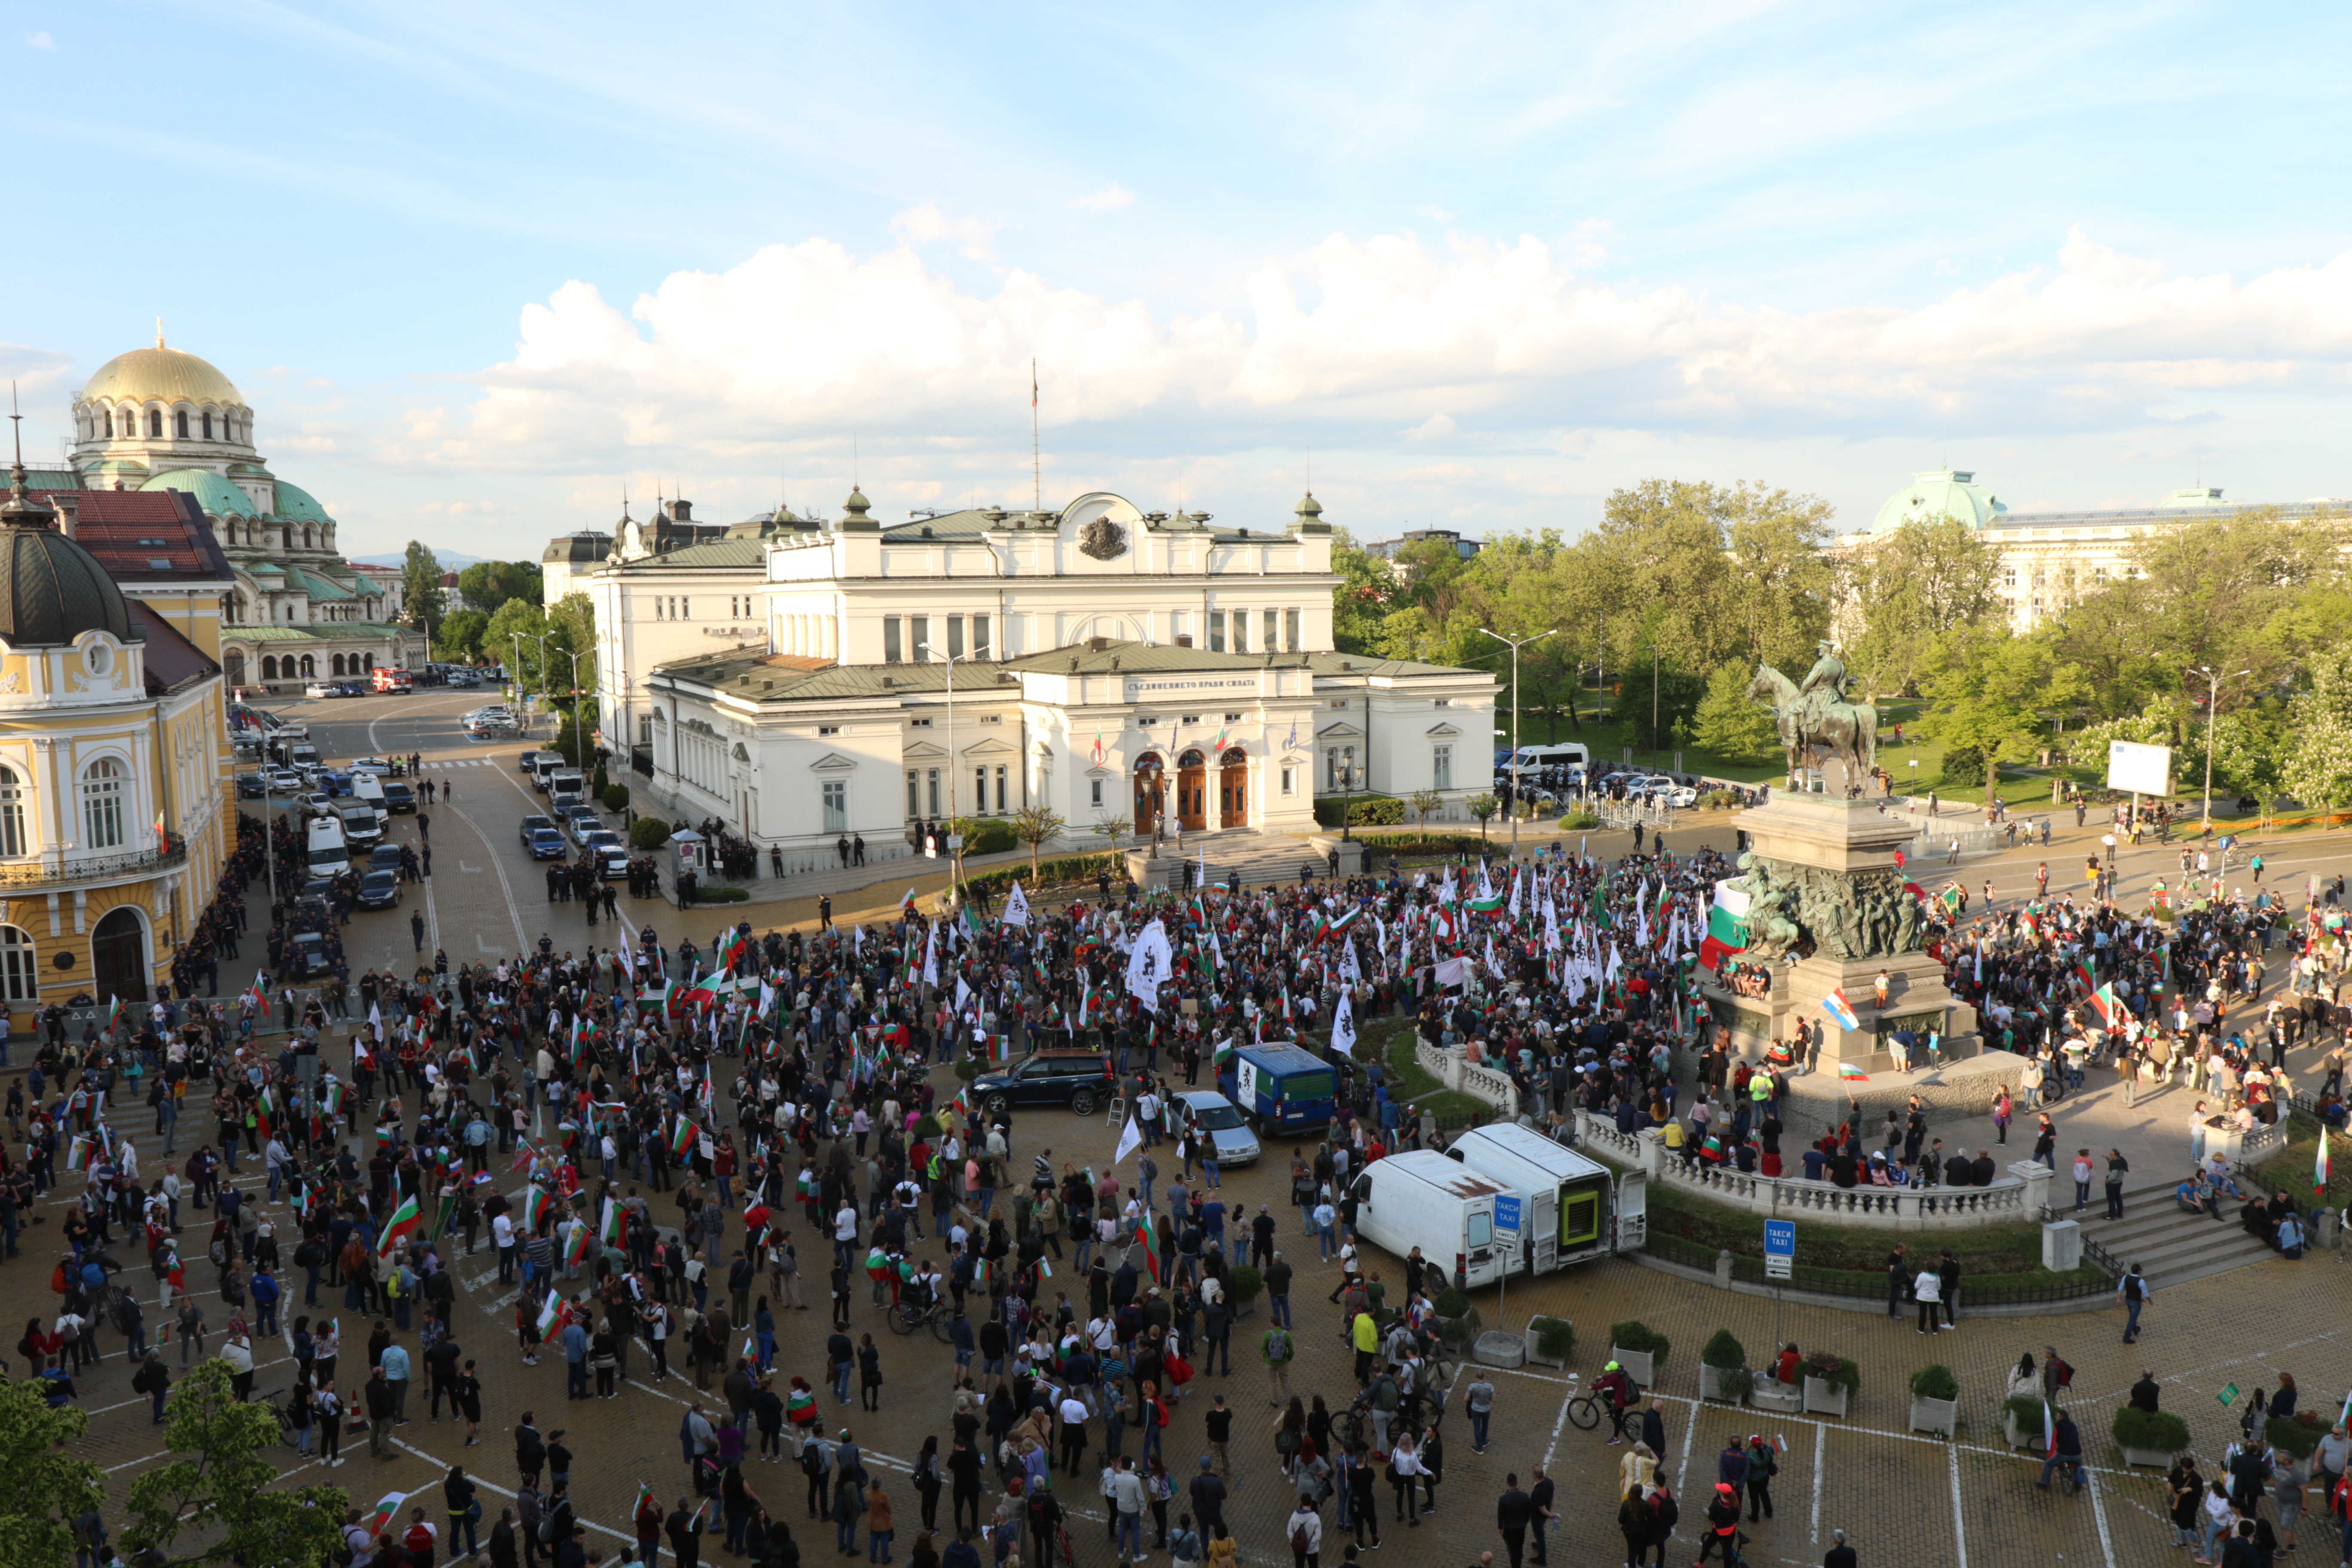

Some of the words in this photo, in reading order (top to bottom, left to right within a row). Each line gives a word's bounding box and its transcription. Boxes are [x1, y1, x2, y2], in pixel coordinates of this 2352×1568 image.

[1128, 681, 1197, 690] СЪЕДИНЕНИЕТО
[1496, 1202, 1519, 1212] ТАКСИ
[1499, 1213, 1515, 1222] TAXI
[1769, 1229, 1791, 1238] ТАКСИ
